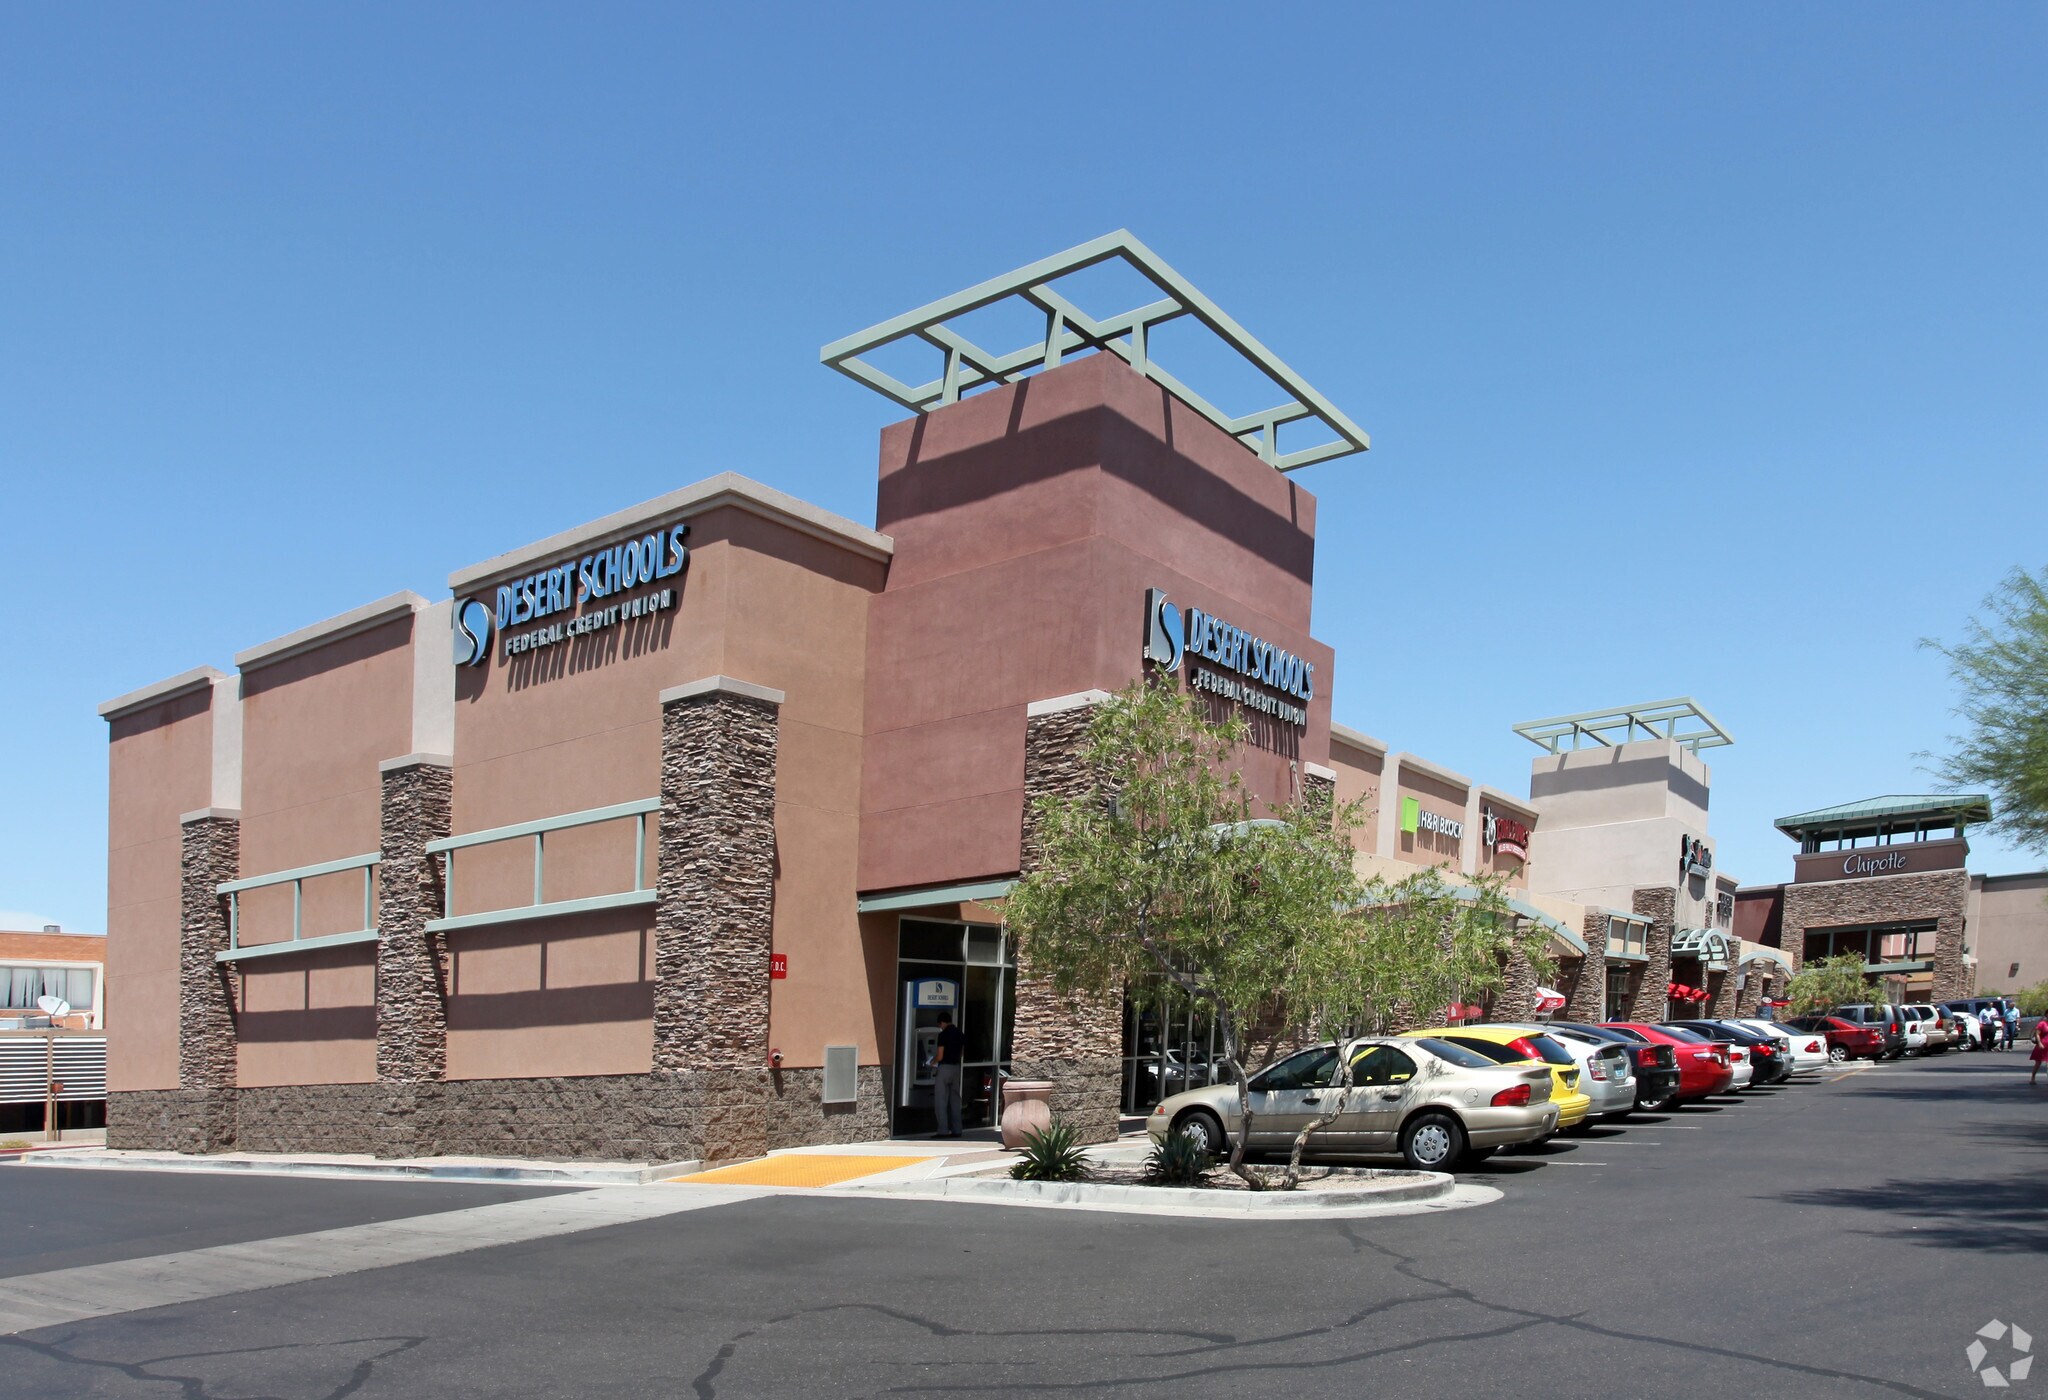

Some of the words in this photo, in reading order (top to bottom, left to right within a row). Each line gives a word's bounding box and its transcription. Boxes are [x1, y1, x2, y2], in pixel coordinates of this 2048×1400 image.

[496, 560, 576, 630] DESERT
[578, 523, 688, 604] SCHOOLS
[505, 622, 564, 656] FEDERAL
[566, 605, 619, 637] CREDIT
[621, 588, 672, 621] UNION
[1189, 607, 1252, 674] DESERT
[1252, 637, 1314, 701] SCHOOLS
[1197, 667, 1242, 700] FEDERAL
[1243, 687, 1277, 714] CREDIT
[1278, 700, 1306, 726] UNION
[1421, 810, 1438, 832] H&R
[1439, 816, 1464, 839] BLOCK
[1843, 852, 1907, 877] Chipotle
